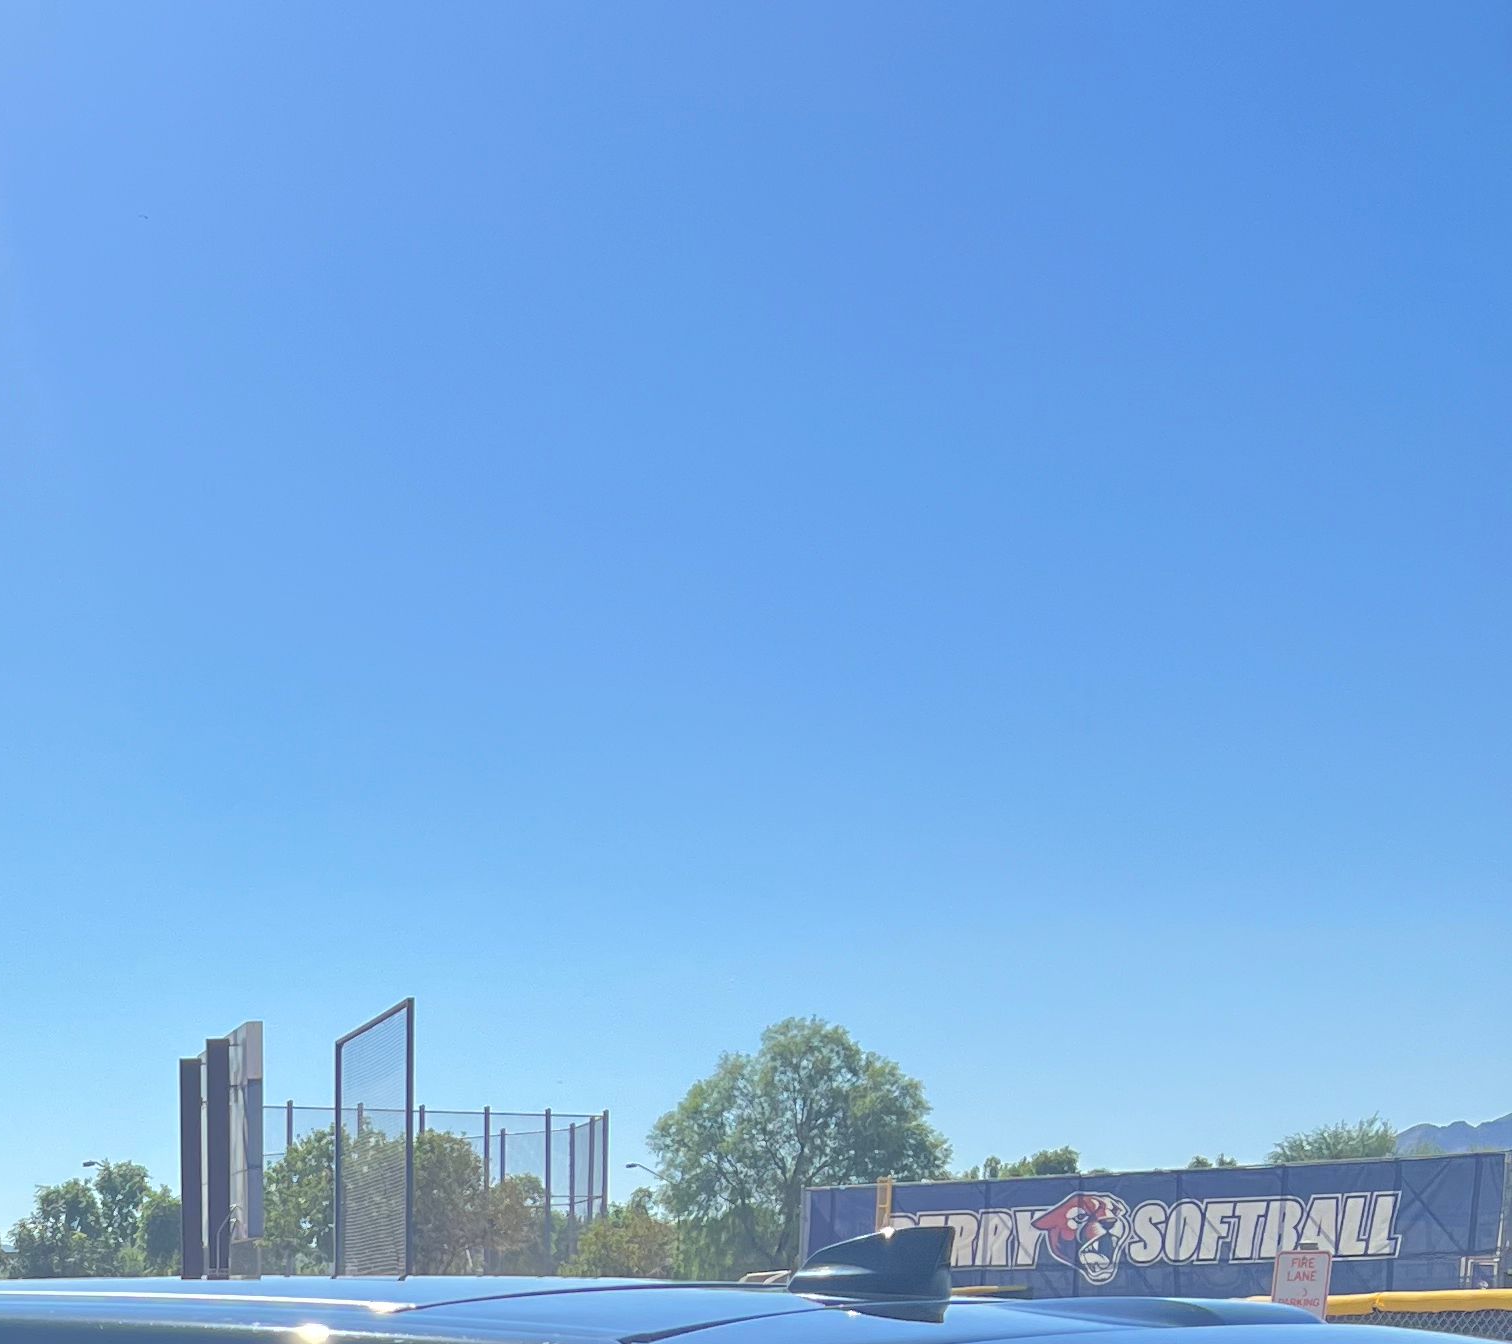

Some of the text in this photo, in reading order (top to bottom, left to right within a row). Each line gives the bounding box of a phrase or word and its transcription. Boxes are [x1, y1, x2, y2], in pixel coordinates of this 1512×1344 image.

[888, 1191, 1402, 1270] RRY SOFTBALL
[1291, 1257, 1315, 1269] FIRE
[1287, 1271, 1317, 1282] LANE
